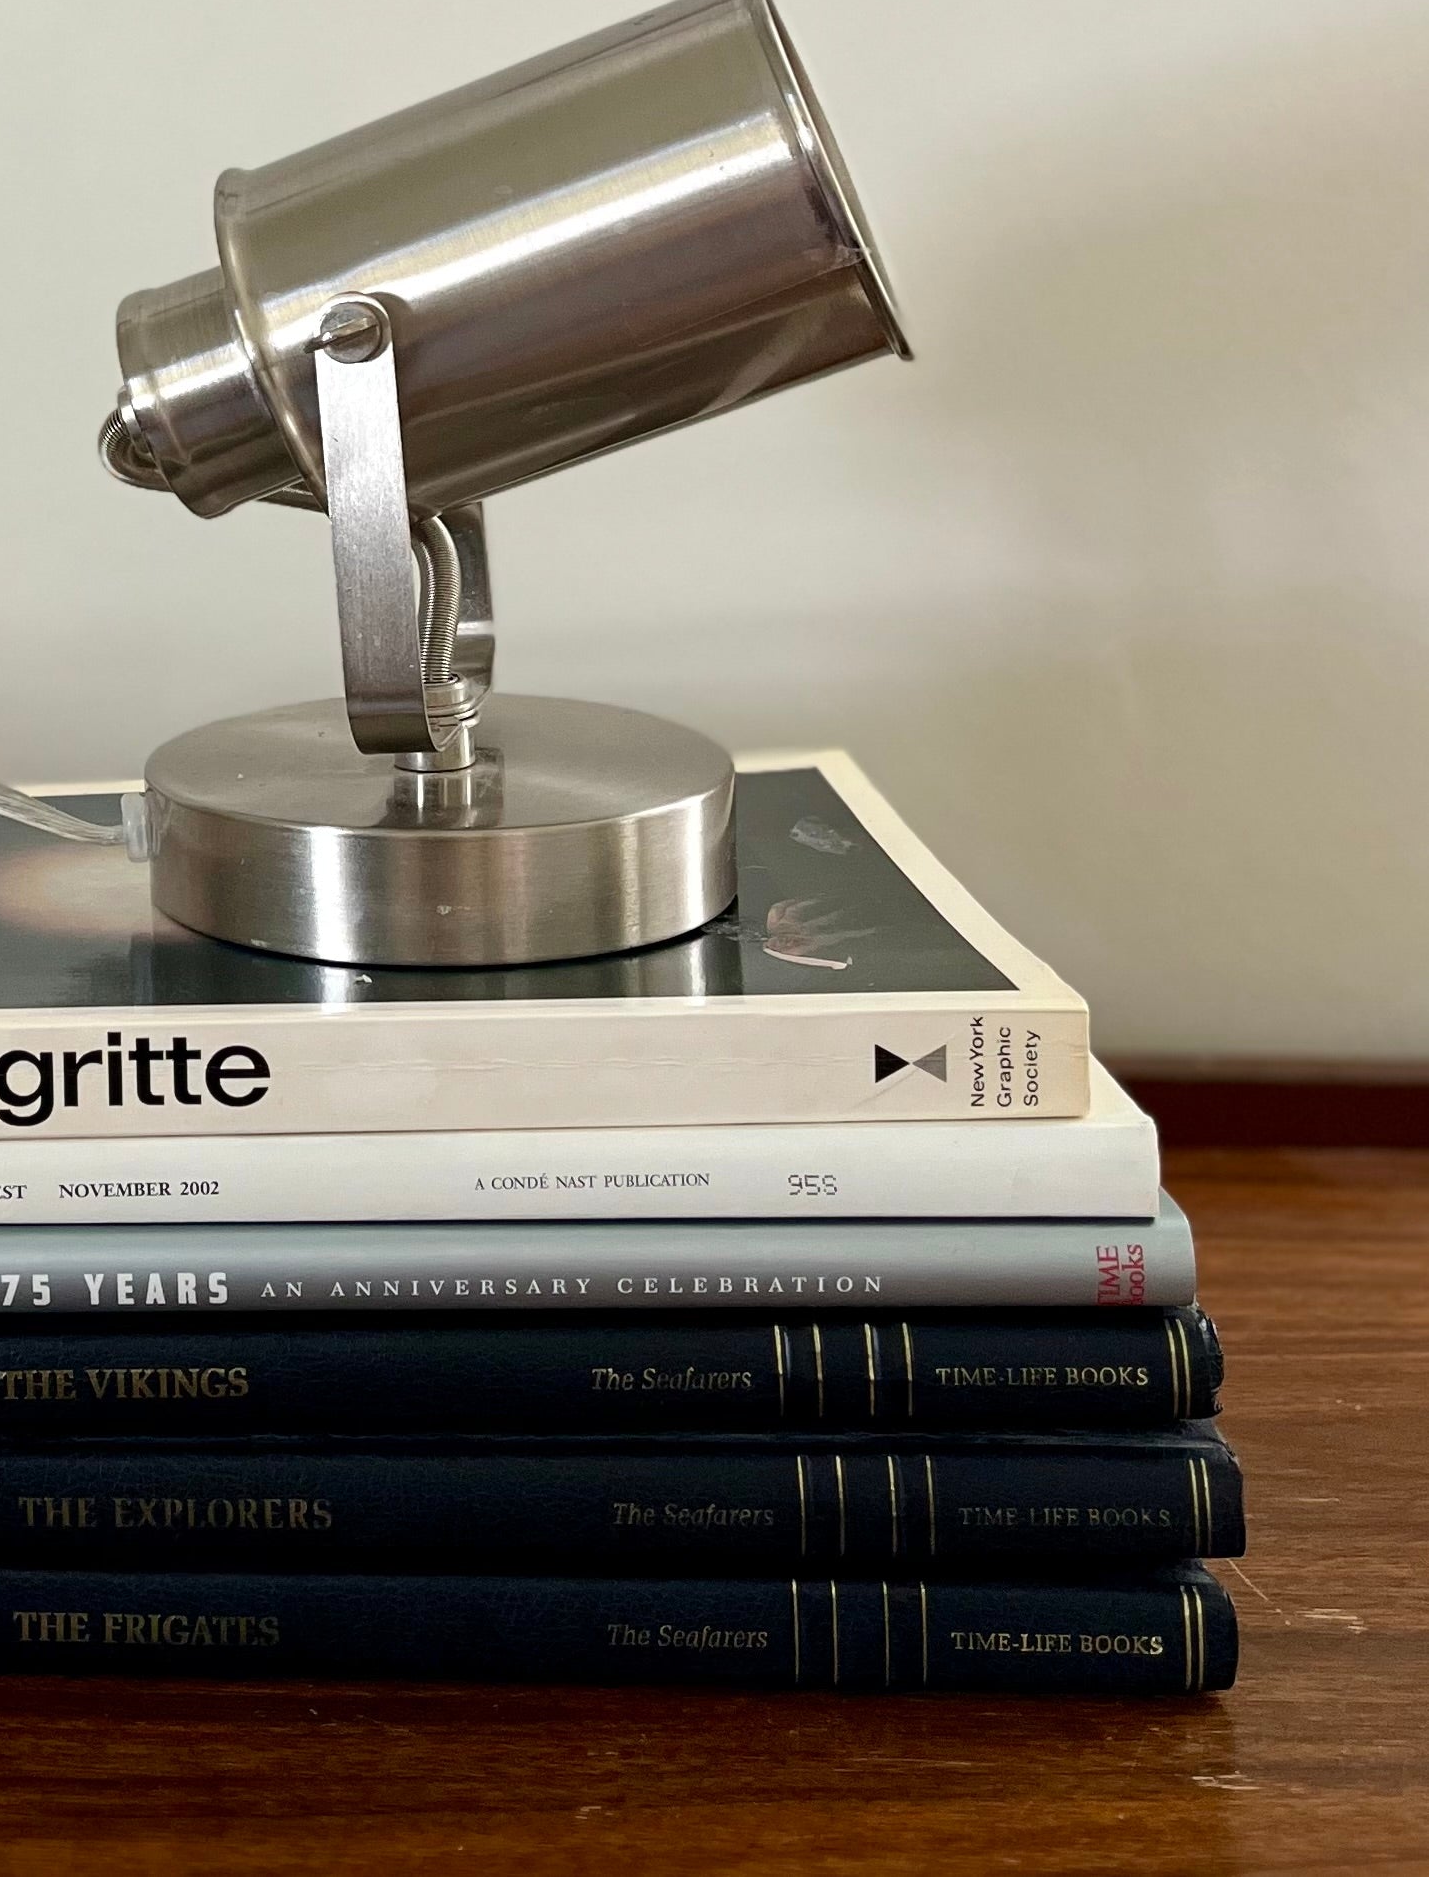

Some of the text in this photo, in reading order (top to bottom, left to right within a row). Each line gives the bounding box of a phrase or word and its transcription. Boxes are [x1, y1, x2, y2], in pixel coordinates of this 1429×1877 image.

[996, 1026, 1014, 1107] Graphic
[1023, 1029, 1041, 1107] Society
[59, 1181, 172, 1200] NOVEMBER
[179, 1180, 220, 1197] 2002
[475, 1172, 710, 1191] A CONDÉ NAST PUBLICATION
[0, 1274, 52, 1306] 75
[84, 1272, 229, 1305] YEARS
[261, 1281, 303, 1298] AN
[331, 1277, 591, 1297] ANNIVERSARY
[616, 1275, 883, 1295] CELEBRATION
[0, 1367, 250, 1400] THE VIKINGS
[591, 1366, 752, 1391] The Seafarers
[1066, 1366, 1149, 1386] BOOKS
[18, 1497, 333, 1530] THE EXPLORERS
[613, 1503, 774, 1529] The Seafarers
[1089, 1509, 1171, 1526] BOOKS
[13, 1611, 280, 1647] THE FRIGATES
[608, 1624, 768, 1651] The Seafarers
[951, 1631, 1164, 1655] TIME-LIFE BOOKS
